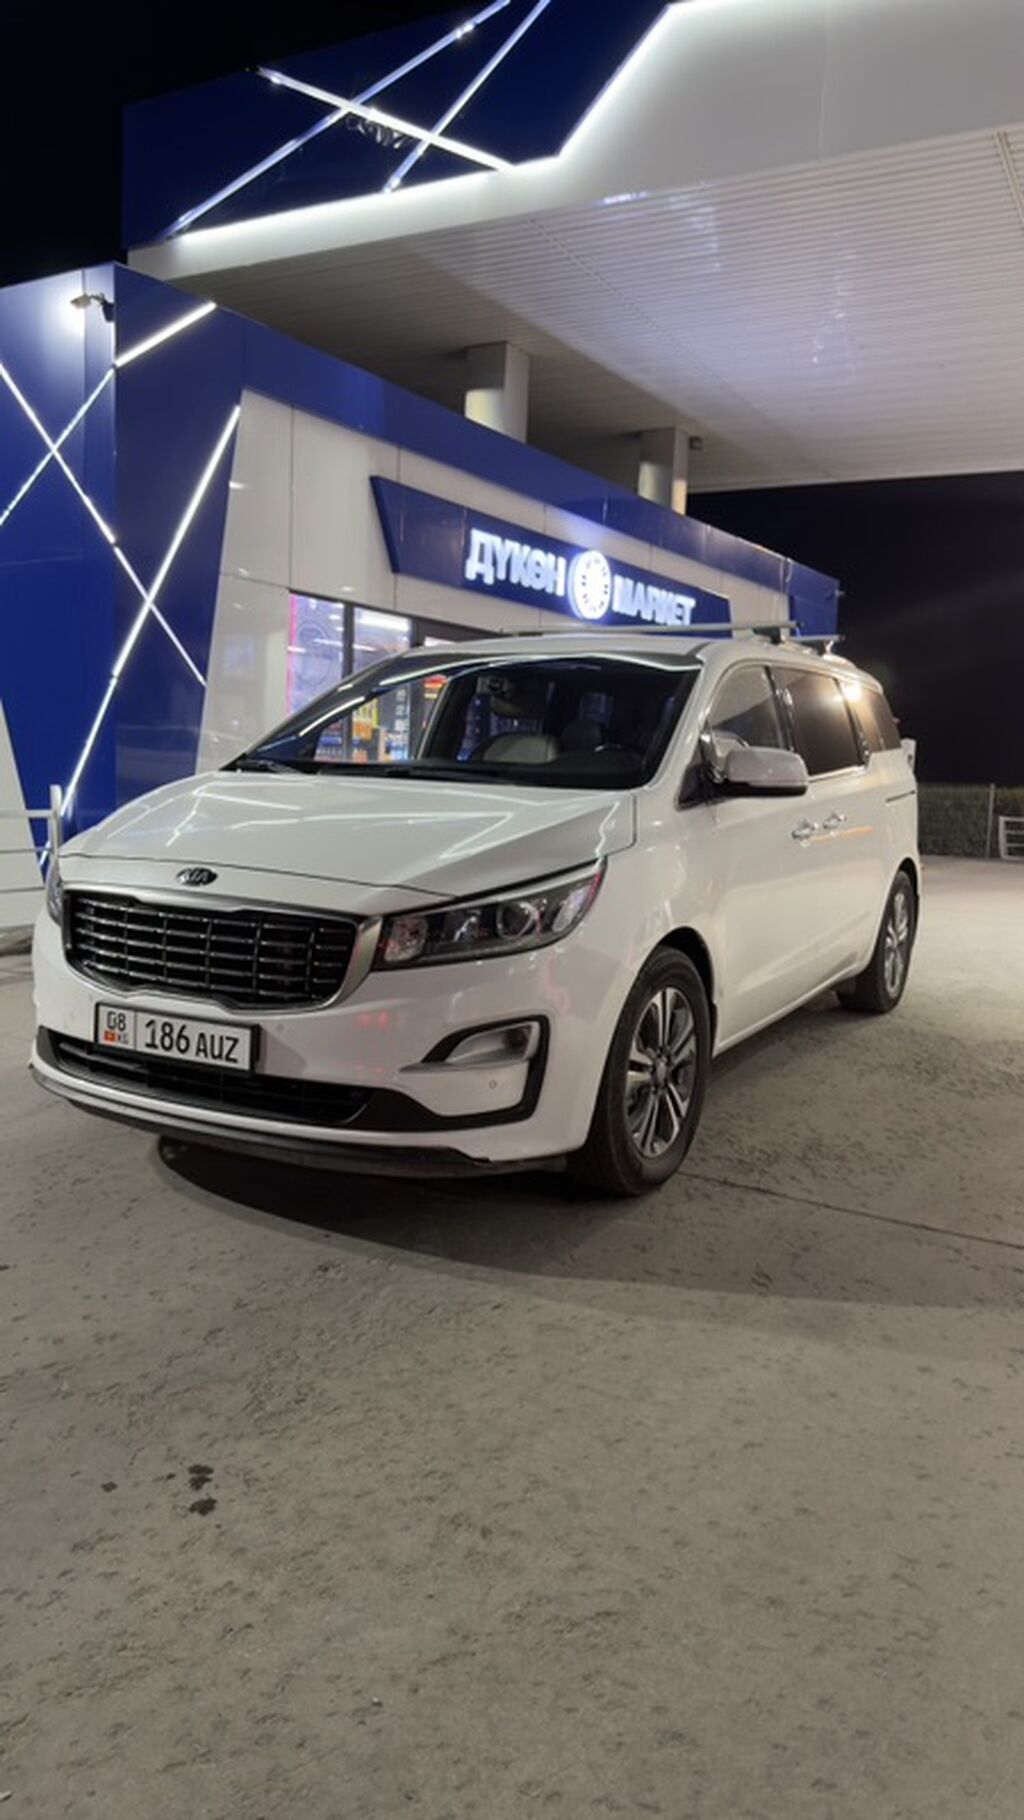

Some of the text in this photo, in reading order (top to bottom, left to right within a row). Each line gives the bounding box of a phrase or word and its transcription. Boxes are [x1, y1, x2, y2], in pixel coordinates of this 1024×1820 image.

[106, 1010, 239, 1063] 08 186 AUZ
